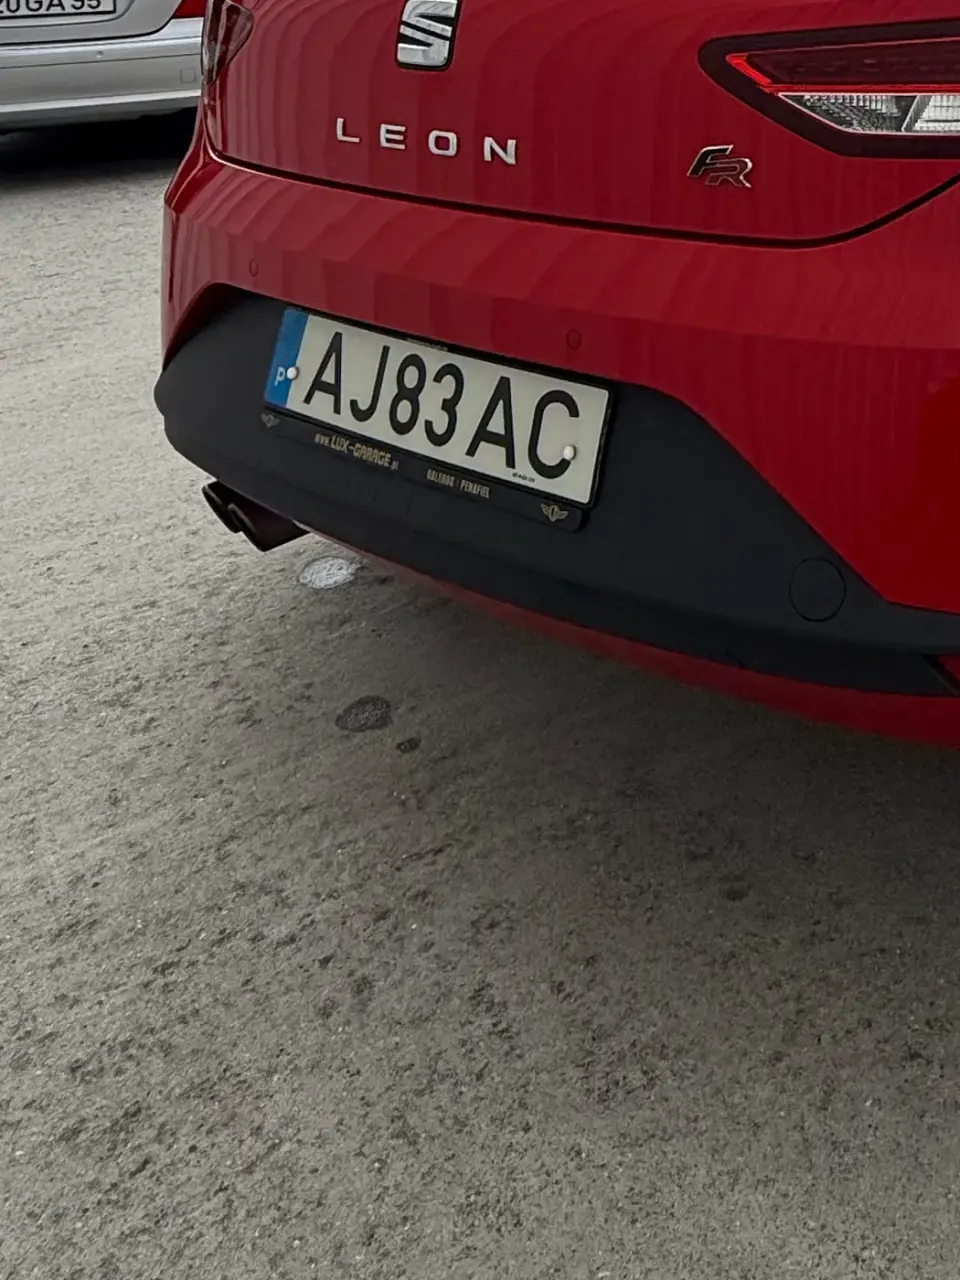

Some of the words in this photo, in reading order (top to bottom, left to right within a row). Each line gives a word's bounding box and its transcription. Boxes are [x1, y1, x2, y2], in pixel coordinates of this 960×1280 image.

[336, 117, 517, 165] LEON
[686, 144, 753, 188] FR
[274, 366, 286, 386] P
[303, 331, 580, 479] AJ83AC
